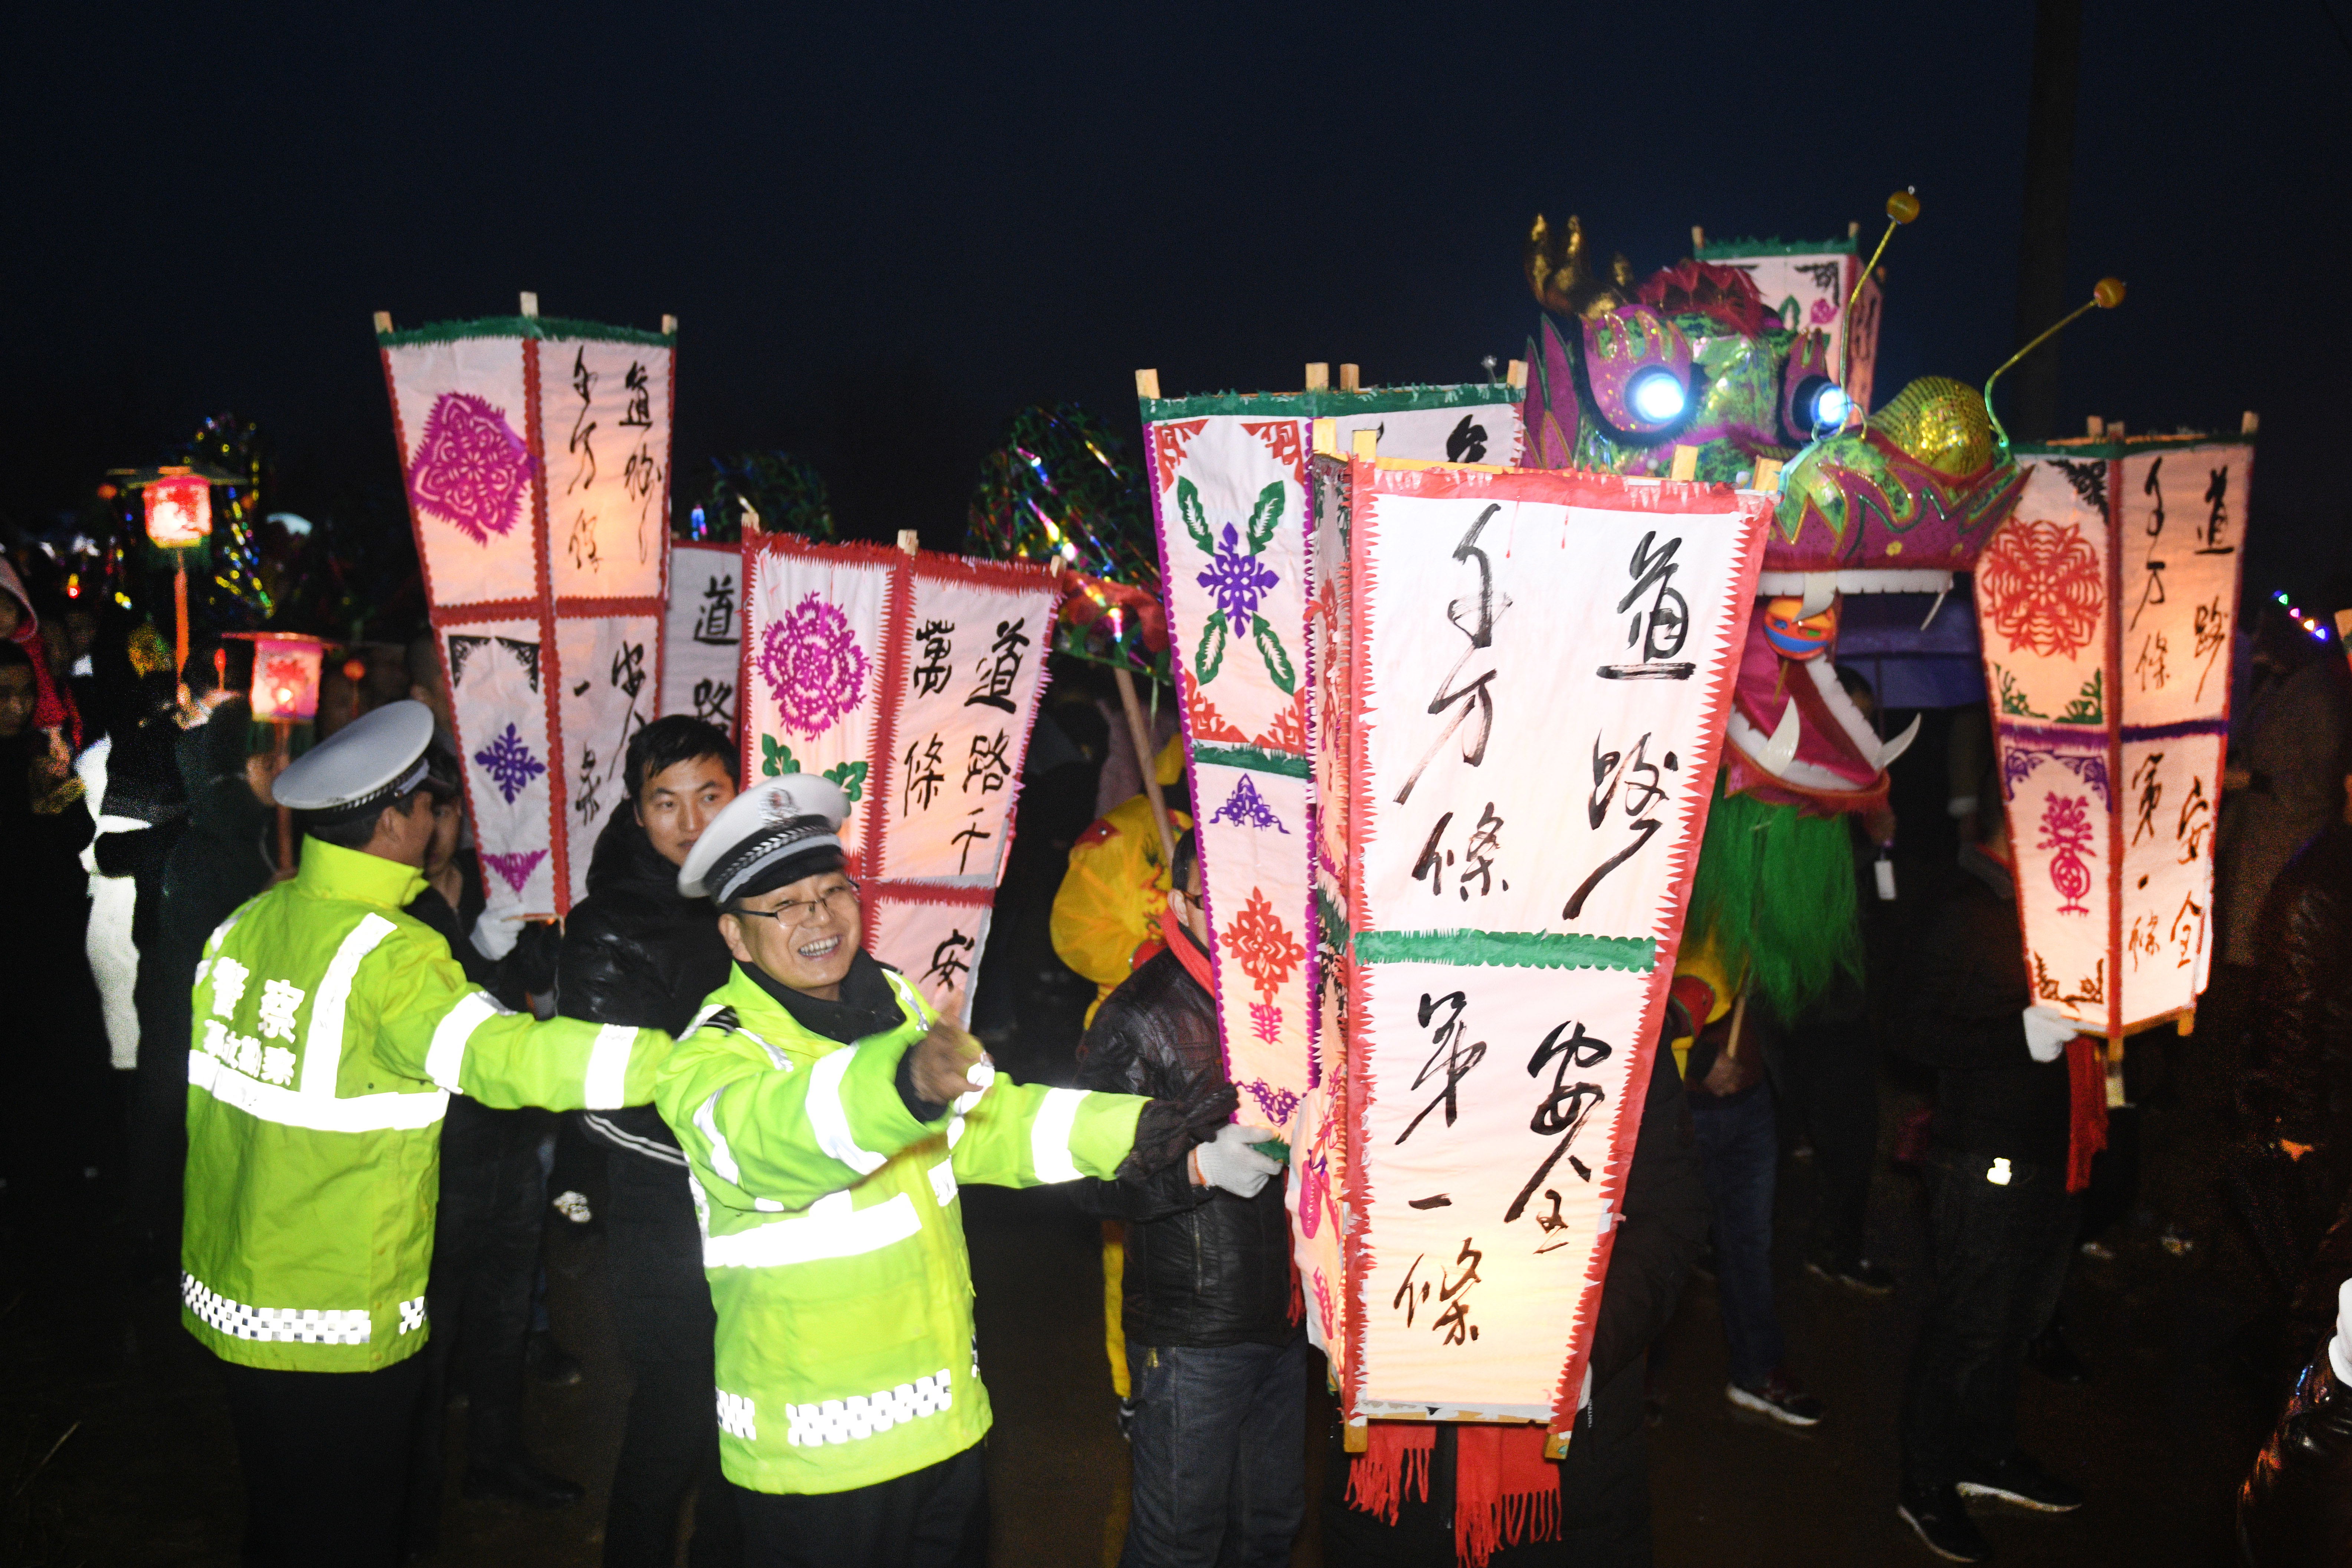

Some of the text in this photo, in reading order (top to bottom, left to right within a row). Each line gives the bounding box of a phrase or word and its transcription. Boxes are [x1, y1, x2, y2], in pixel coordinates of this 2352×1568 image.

[951, 616, 1031, 876] 道路千
[1562, 530, 1696, 920] 道路
[2170, 775, 2210, 969] 安全
[1504, 1020, 1613, 1255] 安全
